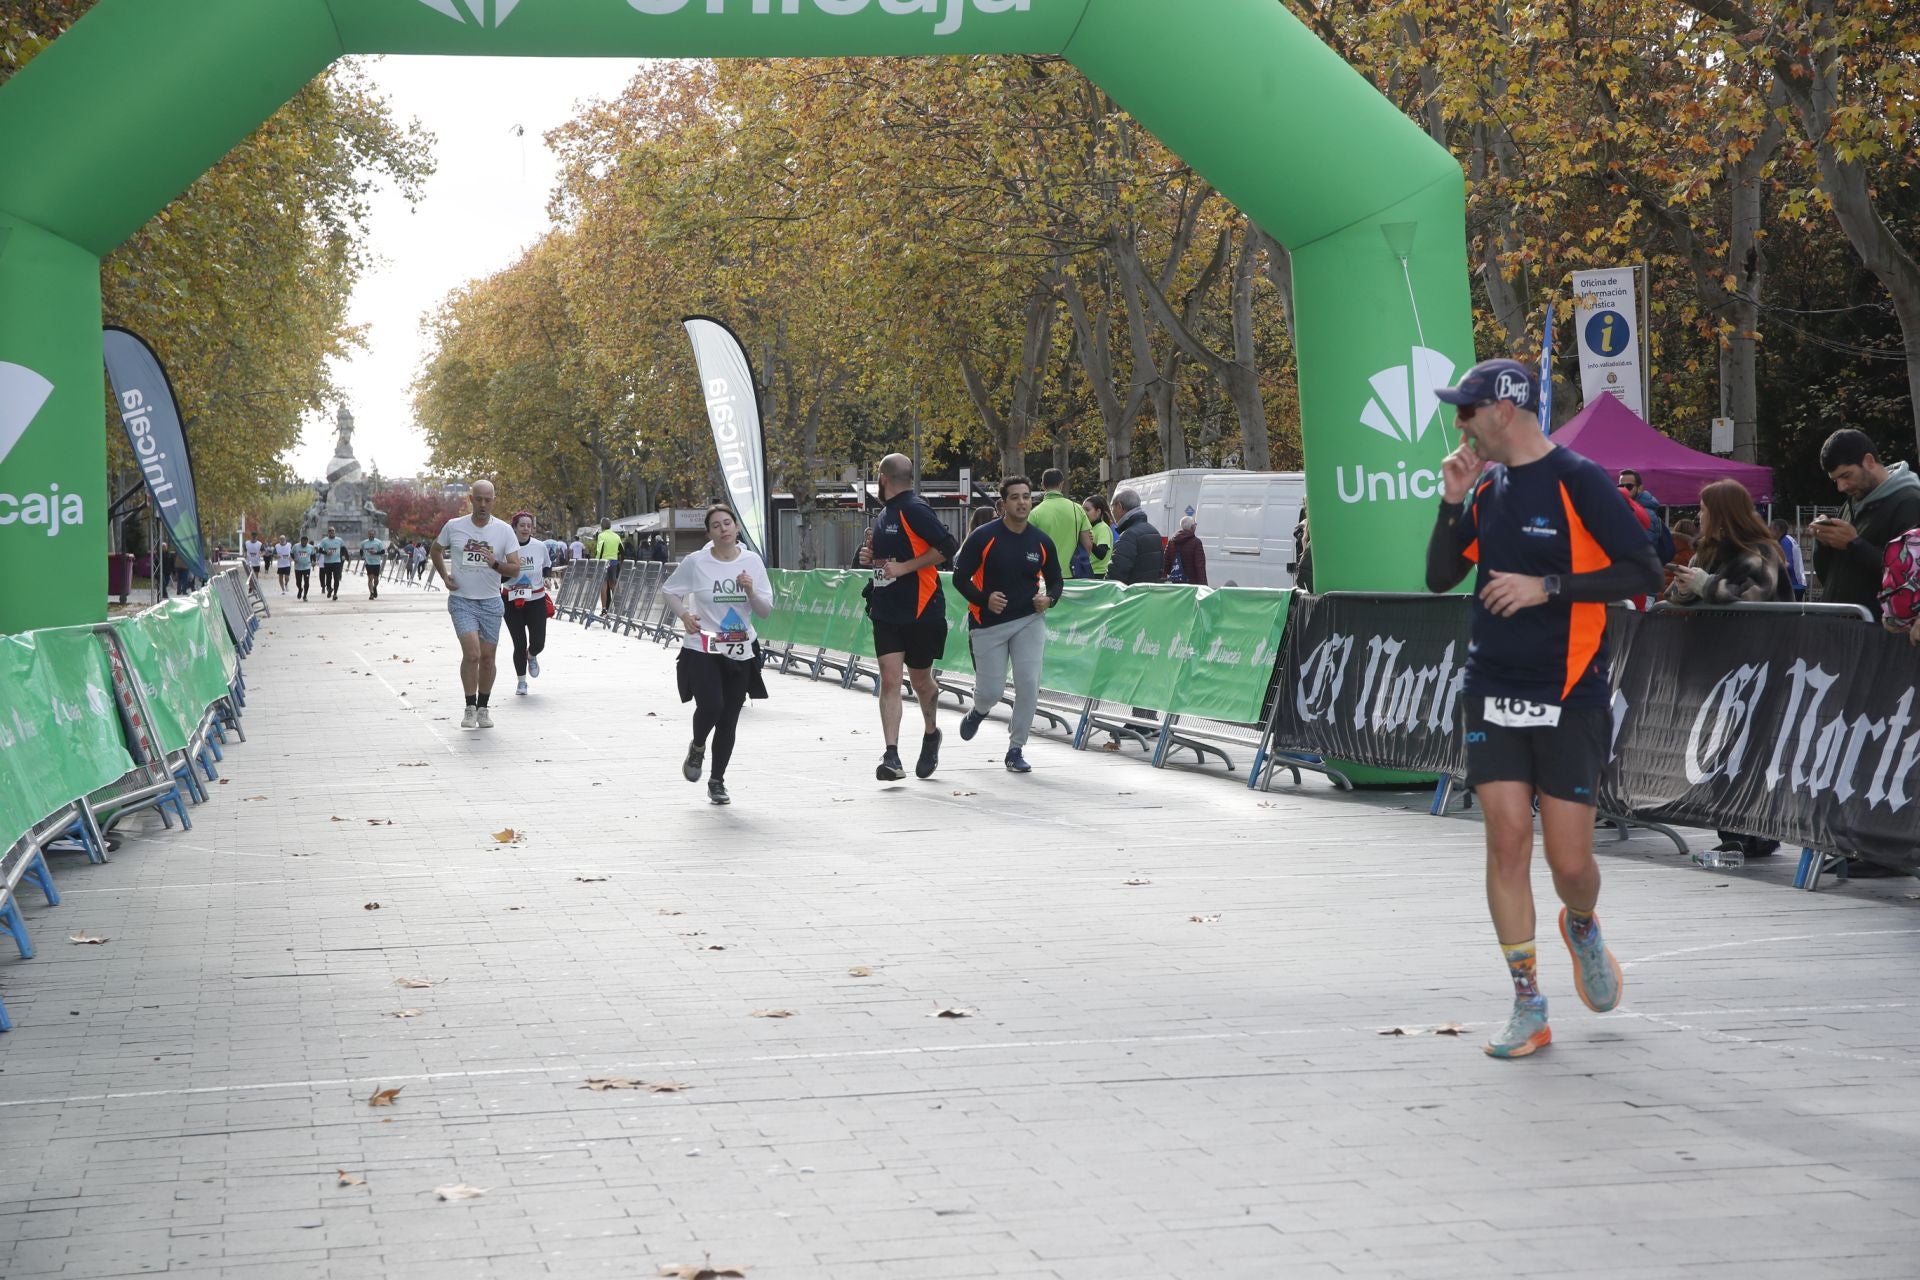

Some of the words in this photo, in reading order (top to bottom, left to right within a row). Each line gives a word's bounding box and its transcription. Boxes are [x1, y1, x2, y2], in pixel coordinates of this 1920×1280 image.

[1581, 278, 1606, 288] Oficina
[1608, 277, 1617, 286] de
[1499, 374, 1529, 403] Buff
[1336, 461, 1445, 503] Unic
[874, 569, 884, 580] 46
[726, 643, 745, 655] 73
[1495, 697, 1546, 717] 465
